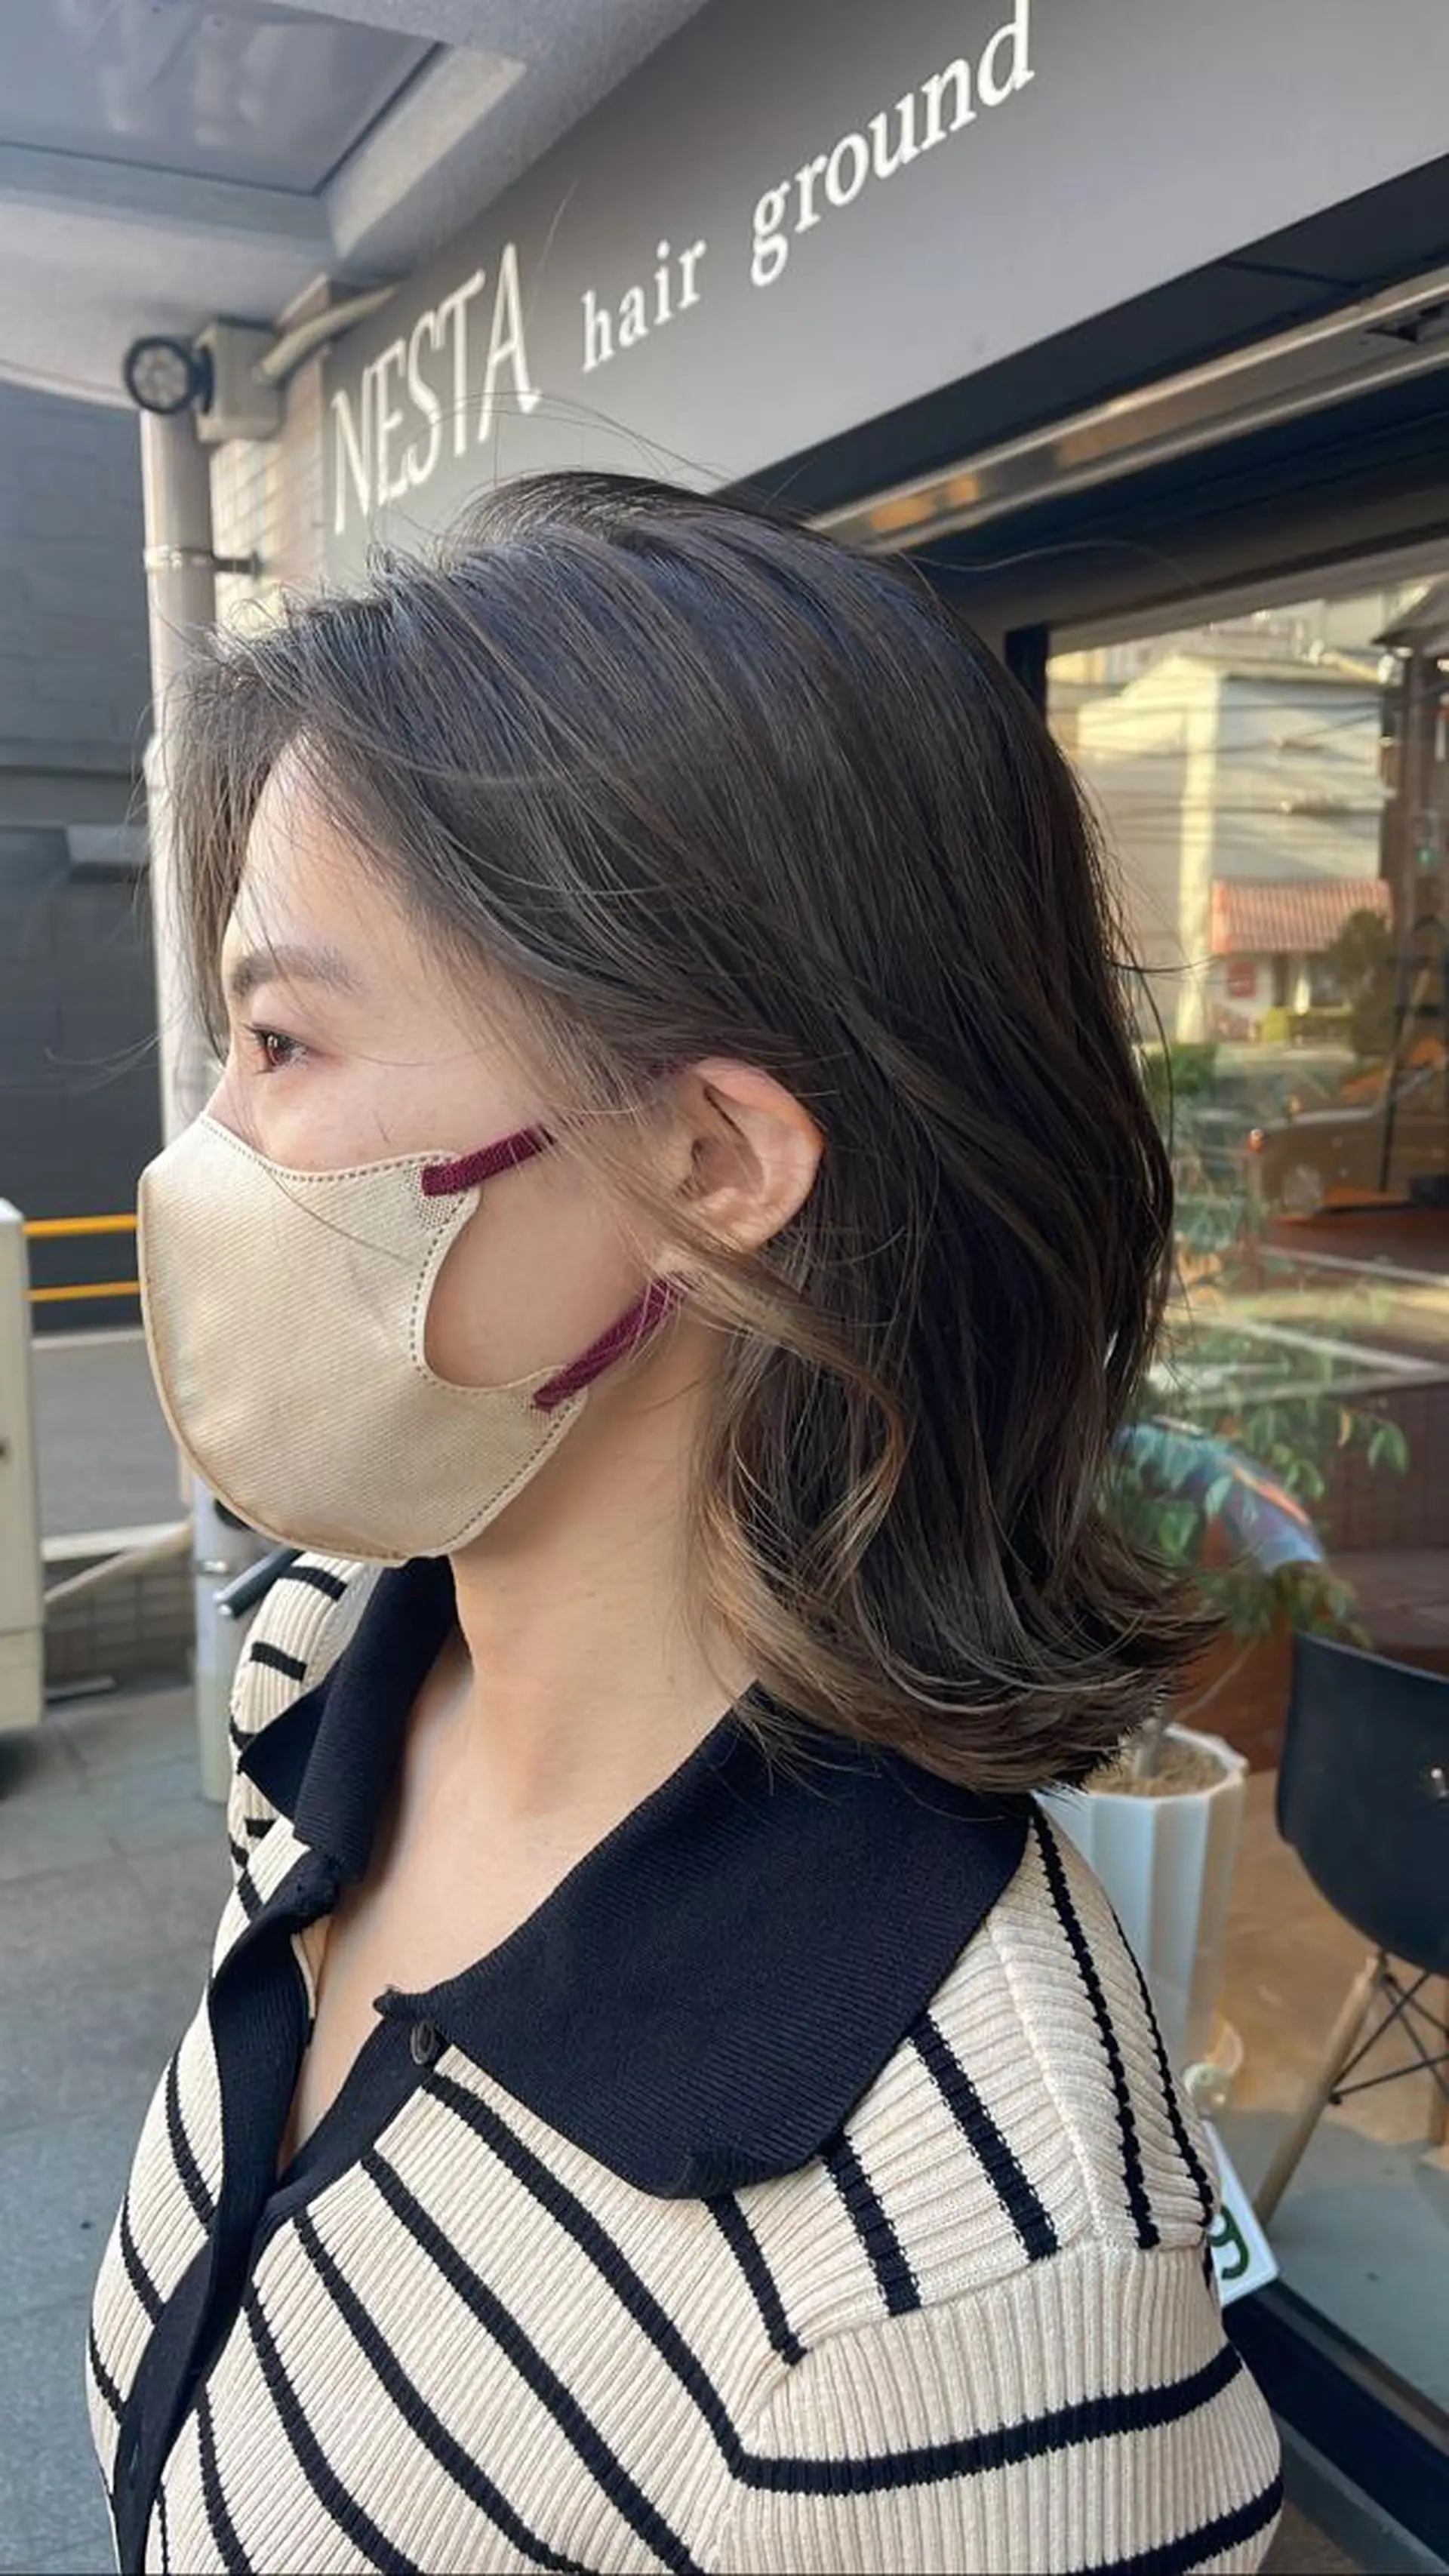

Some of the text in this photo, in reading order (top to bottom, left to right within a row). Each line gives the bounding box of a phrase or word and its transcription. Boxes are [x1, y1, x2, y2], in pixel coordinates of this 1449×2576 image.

[331, 0, 1035, 535] NESTA hair ground
